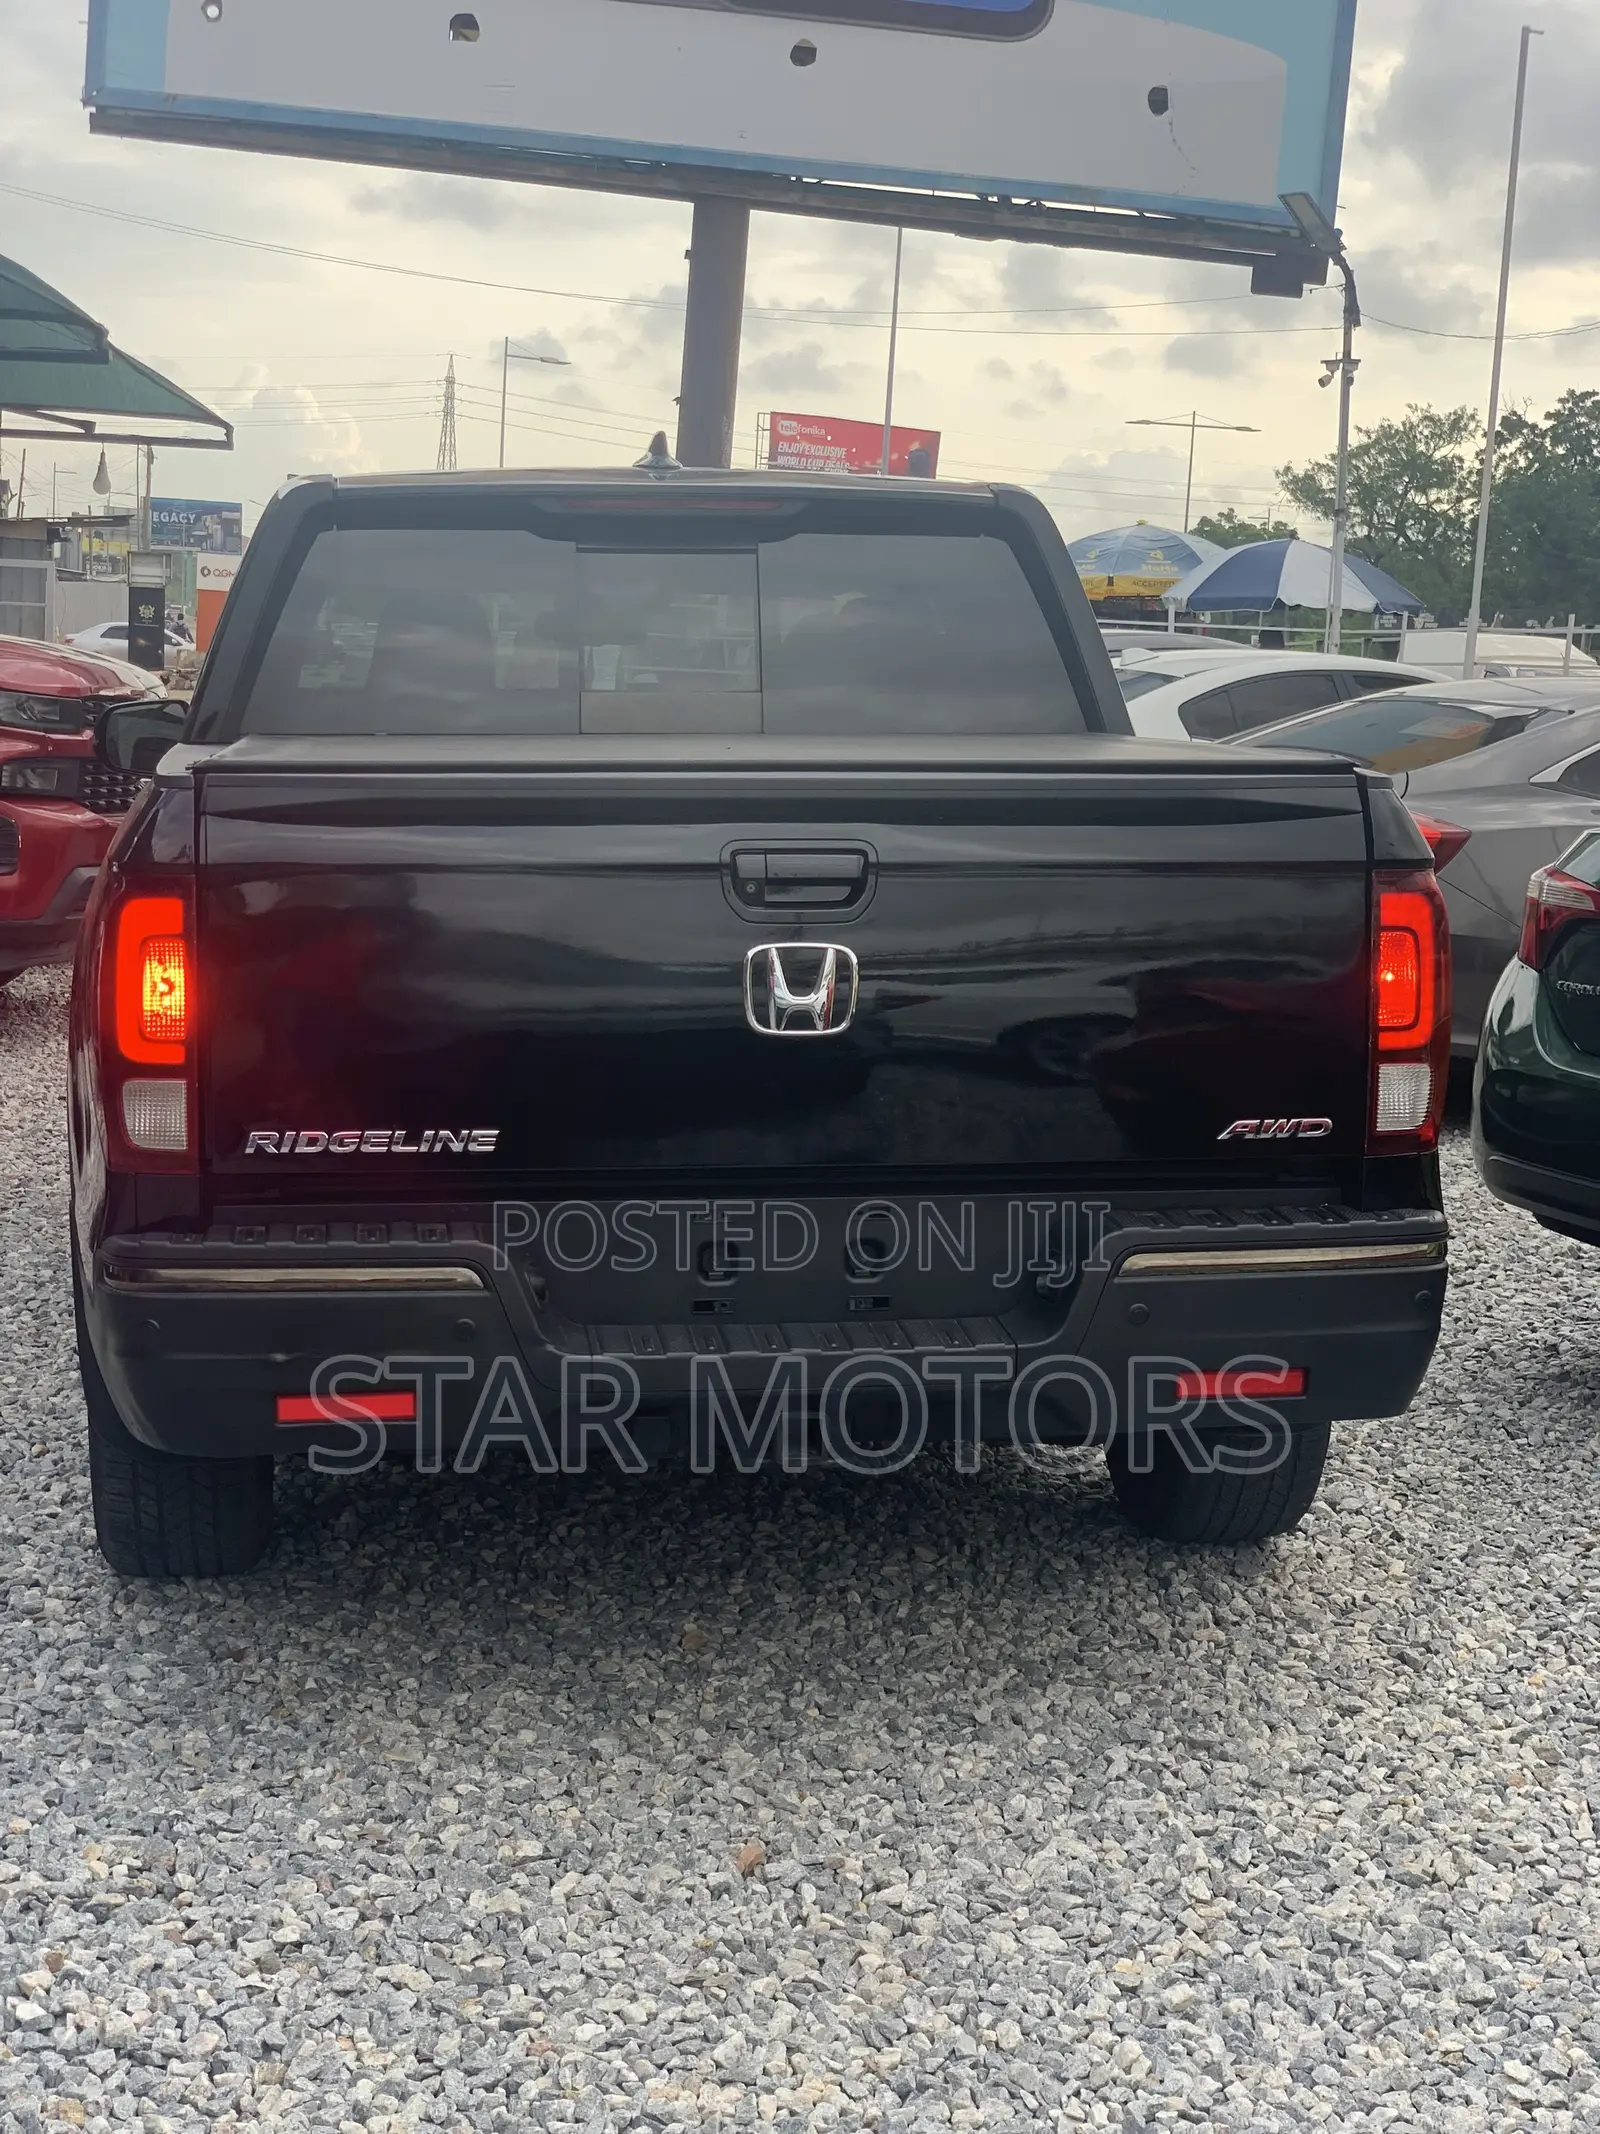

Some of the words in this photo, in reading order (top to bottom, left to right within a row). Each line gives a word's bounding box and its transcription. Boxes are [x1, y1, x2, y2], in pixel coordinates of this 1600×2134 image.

[780, 421, 826, 436] telefonika
[778, 441, 805, 454] ENJOY
[805, 443, 848, 459] EXCLUSIVE
[152, 511, 197, 524] EGACY
[1141, 563, 1179, 573] MoMo
[1216, 1117, 1333, 1140] AWD
[244, 1129, 500, 1154] RIDGELINE
